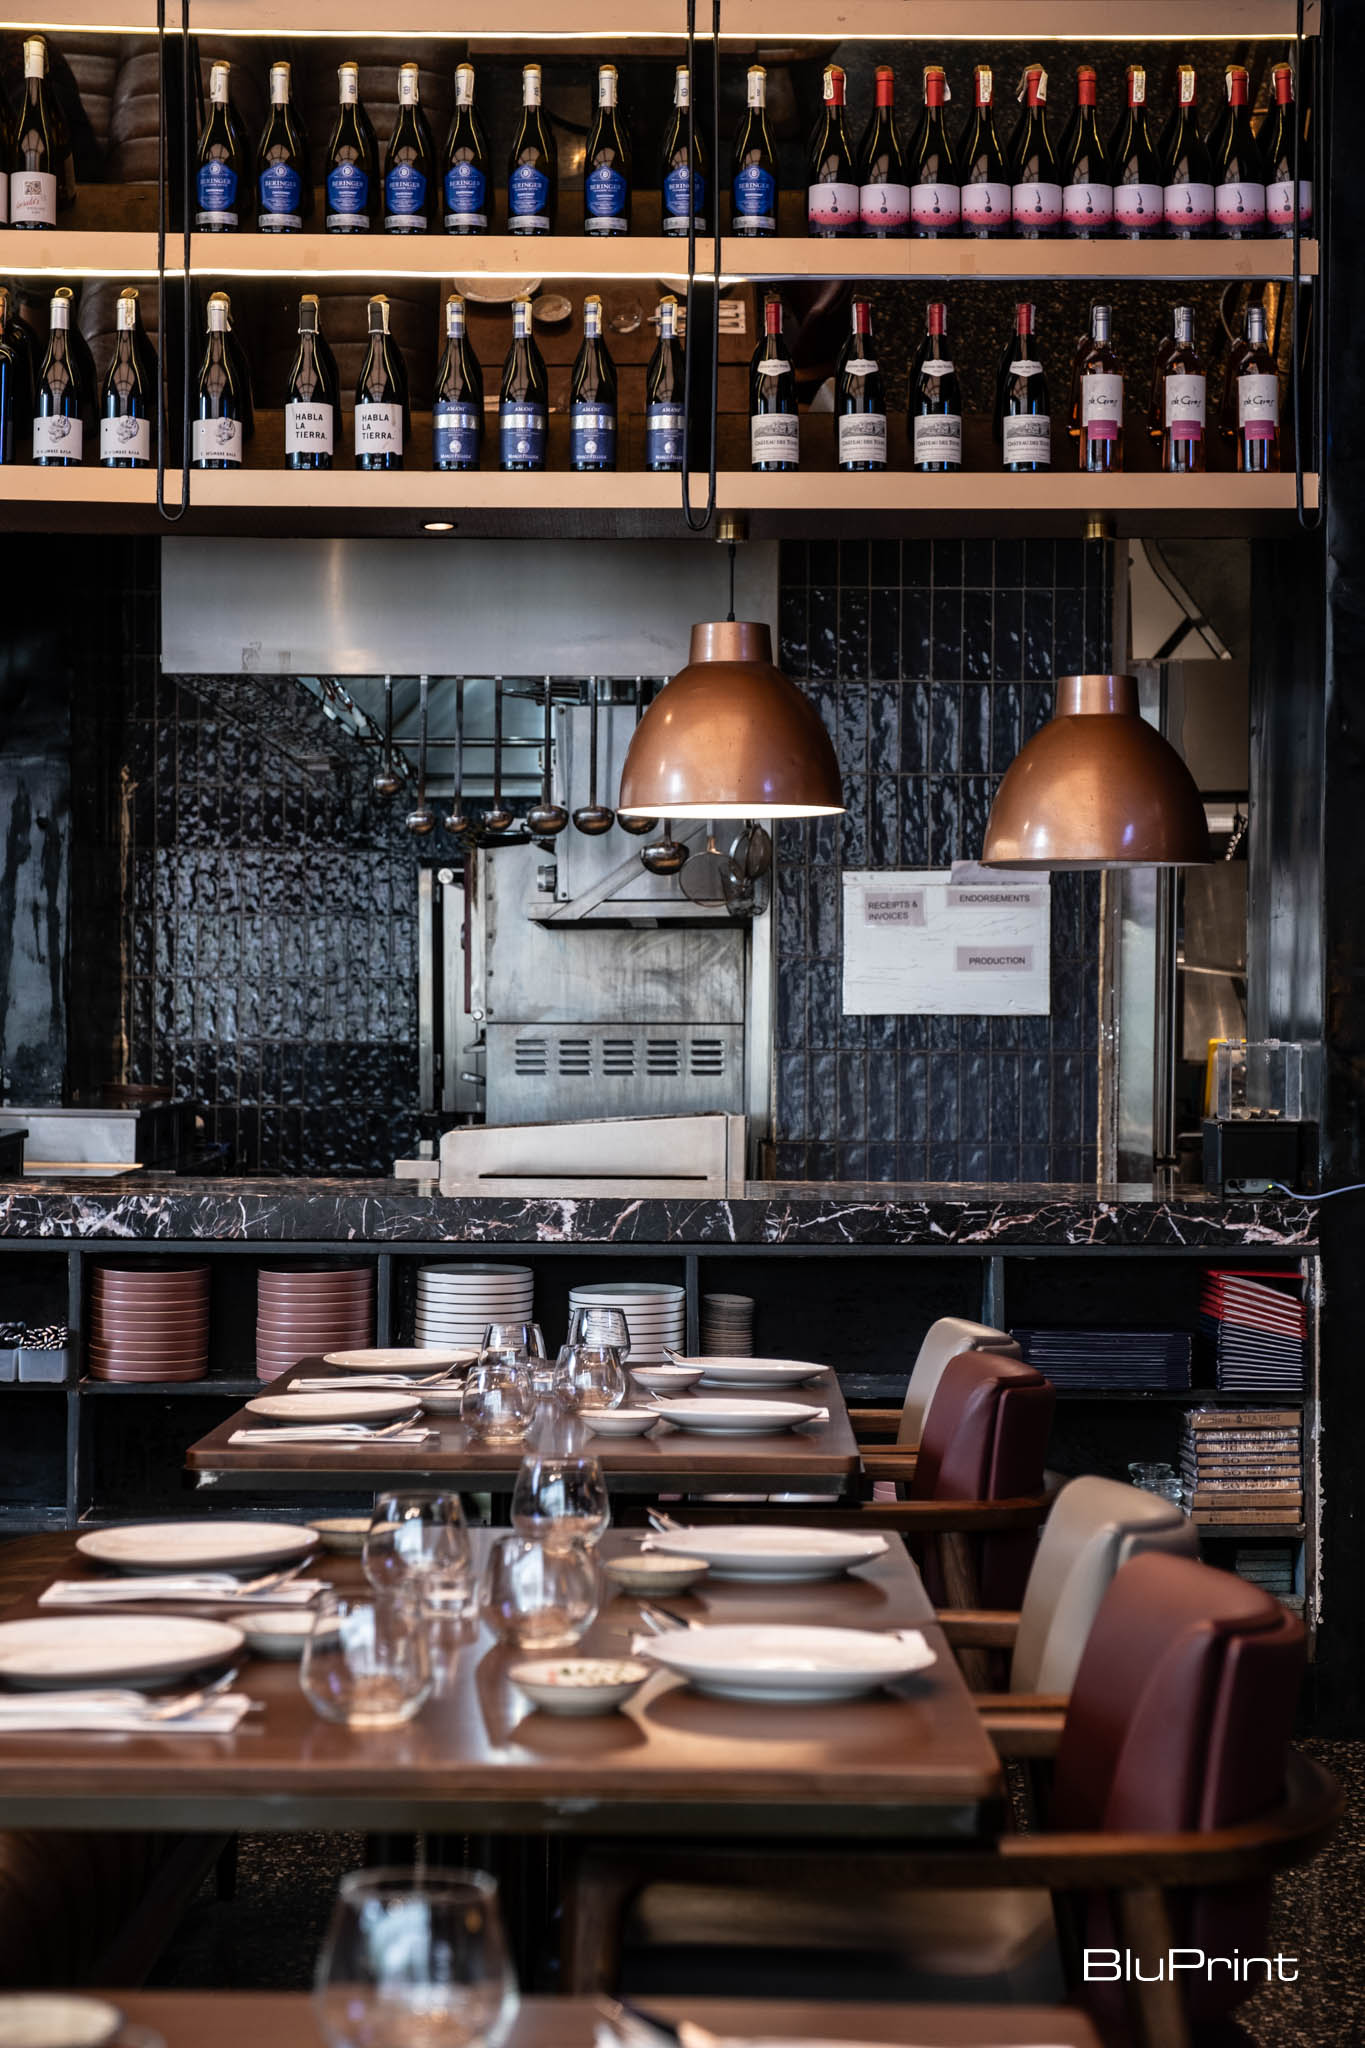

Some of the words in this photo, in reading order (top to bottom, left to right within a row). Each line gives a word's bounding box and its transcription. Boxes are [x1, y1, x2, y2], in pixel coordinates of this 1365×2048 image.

[295, 413, 323, 421] HABLA
[362, 413, 390, 421] HABLA
[295, 422, 305, 430] LA
[362, 423, 371, 431] LA
[295, 431, 328, 440] TIERRA.
[362, 432, 394, 440] TIERRA.
[959, 894, 1030, 903] ENDORSEMENTS
[868, 901, 910, 910] RECEIPTS
[868, 912, 909, 920] INVOICES
[968, 957, 1026, 965] PRODUCTION
